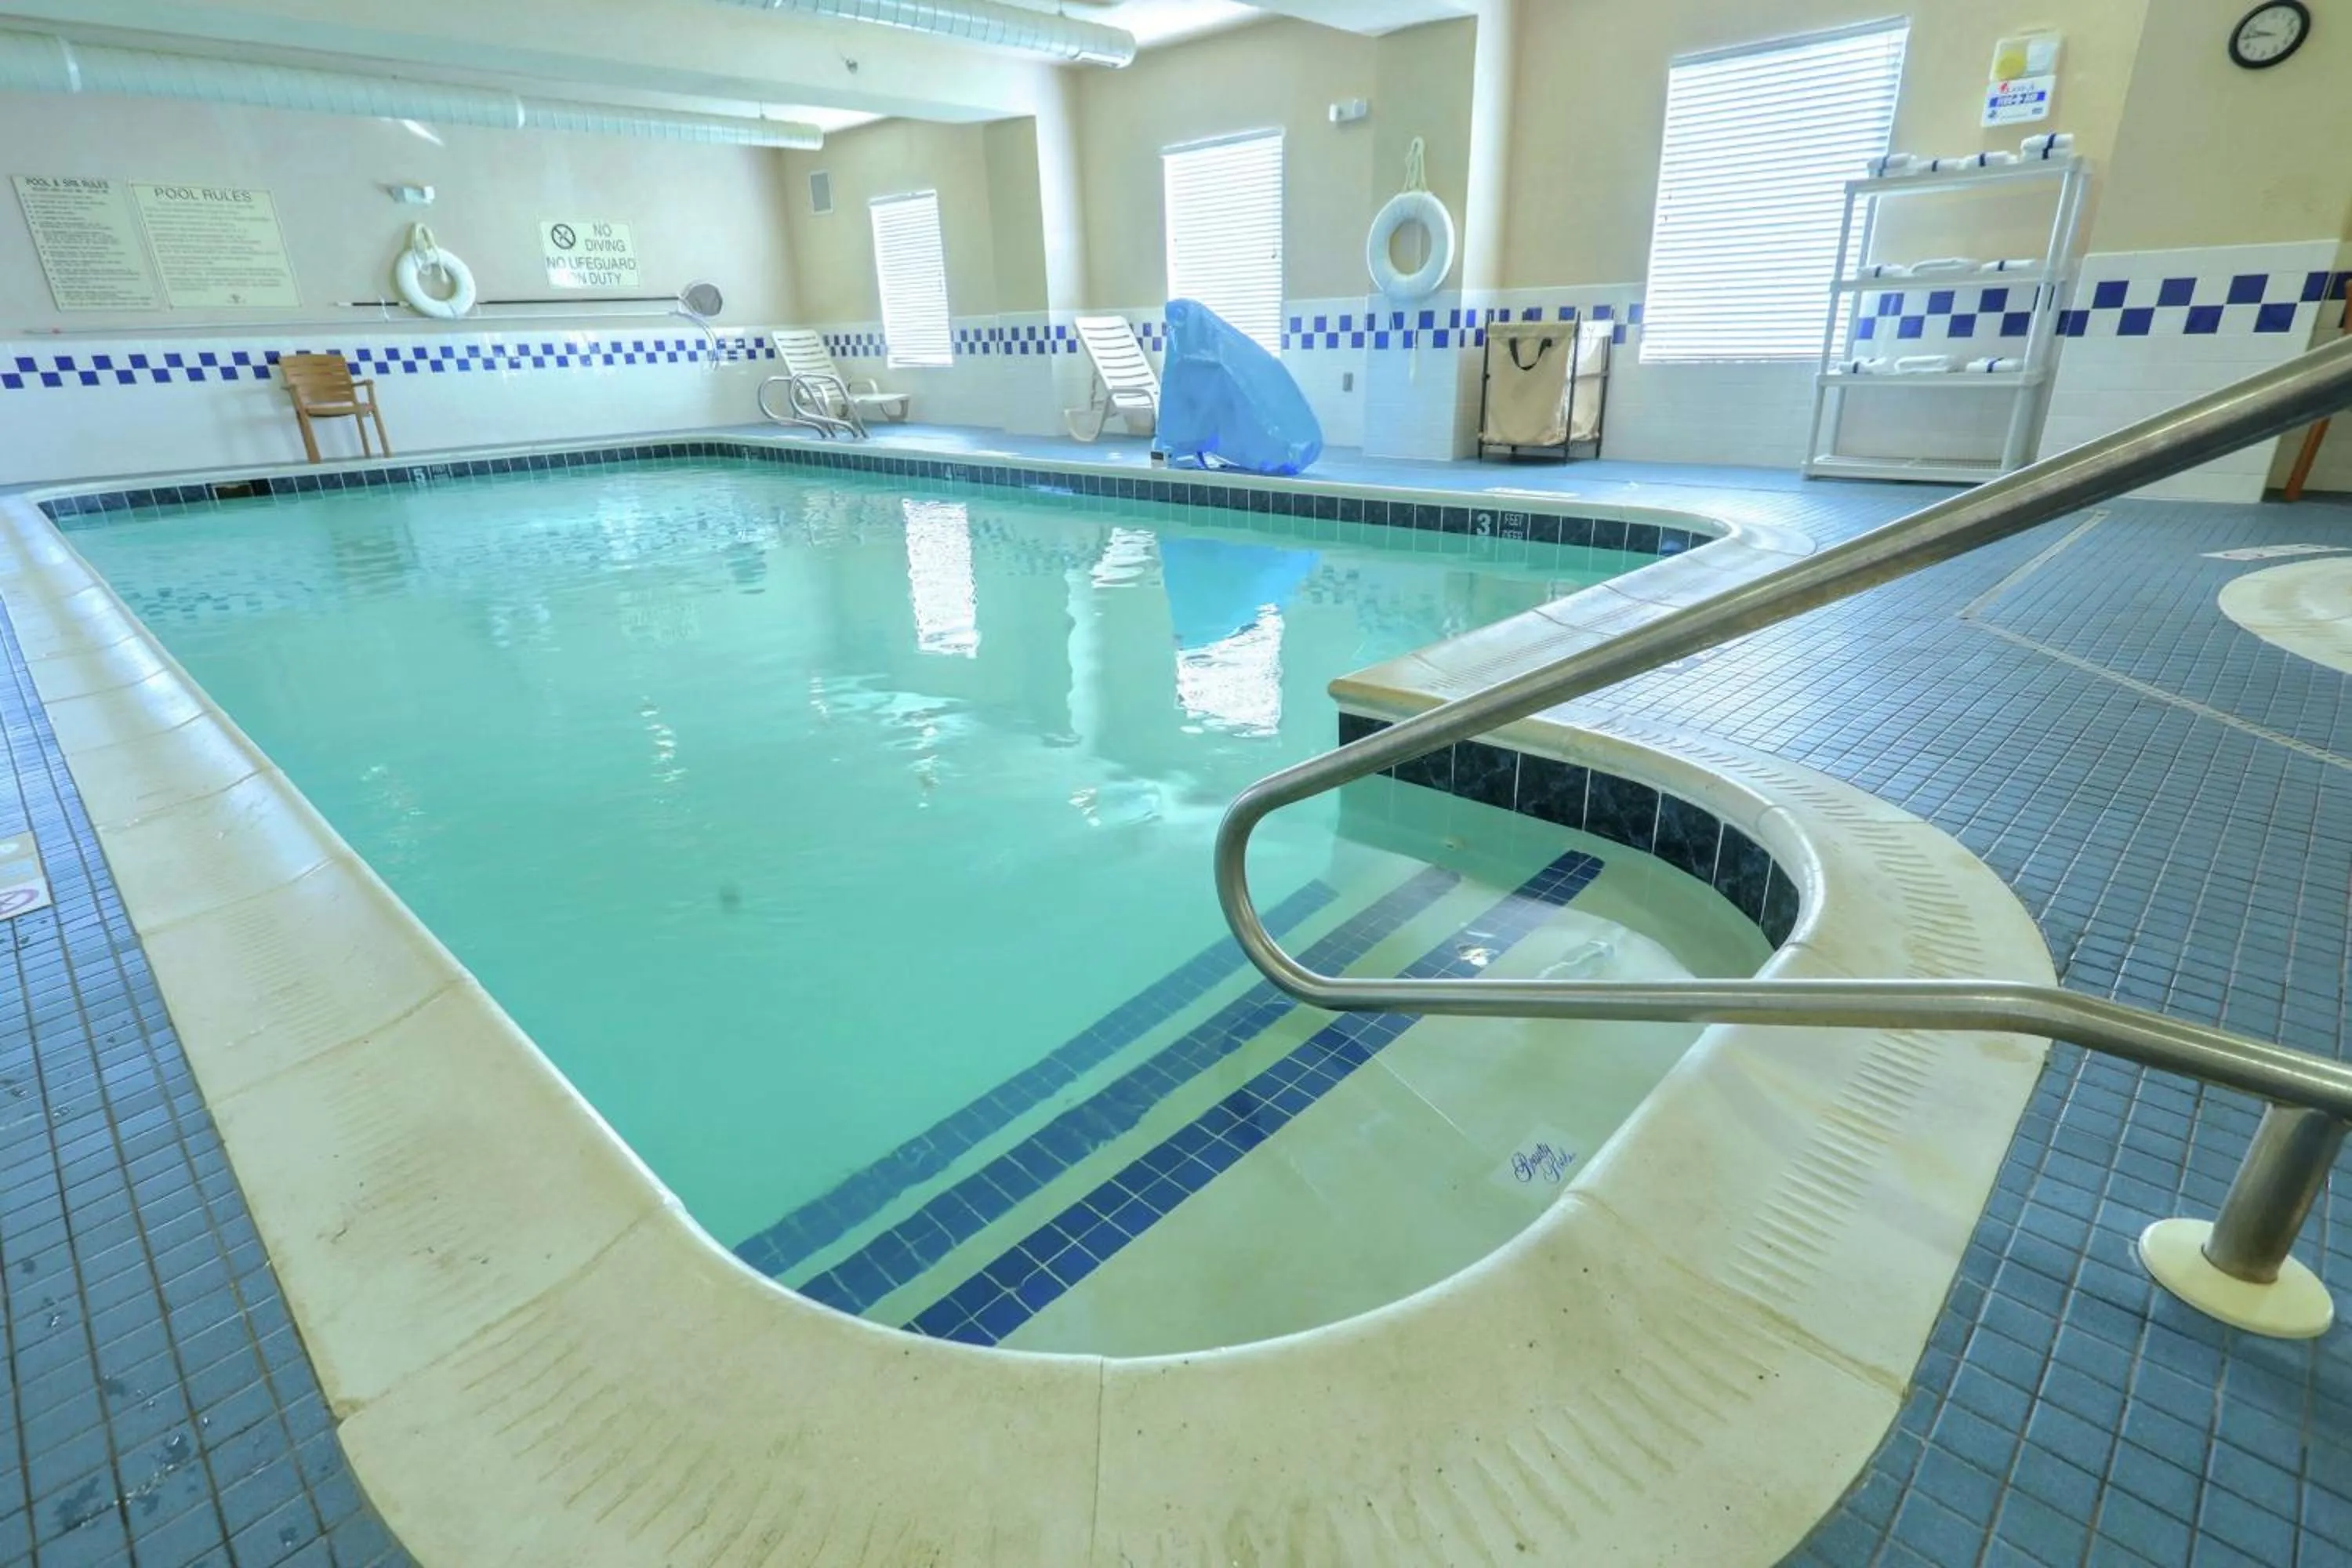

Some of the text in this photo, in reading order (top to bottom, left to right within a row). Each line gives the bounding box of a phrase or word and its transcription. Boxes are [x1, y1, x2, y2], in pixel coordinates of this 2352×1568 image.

[154, 187, 252, 202] POOL RULES
[593, 223, 612, 237] NO
[584, 238, 626, 252] DIVING
[546, 256, 566, 270] NO
[589, 272, 622, 285] DUTY
[1476, 513, 1524, 535] 3 FEET
